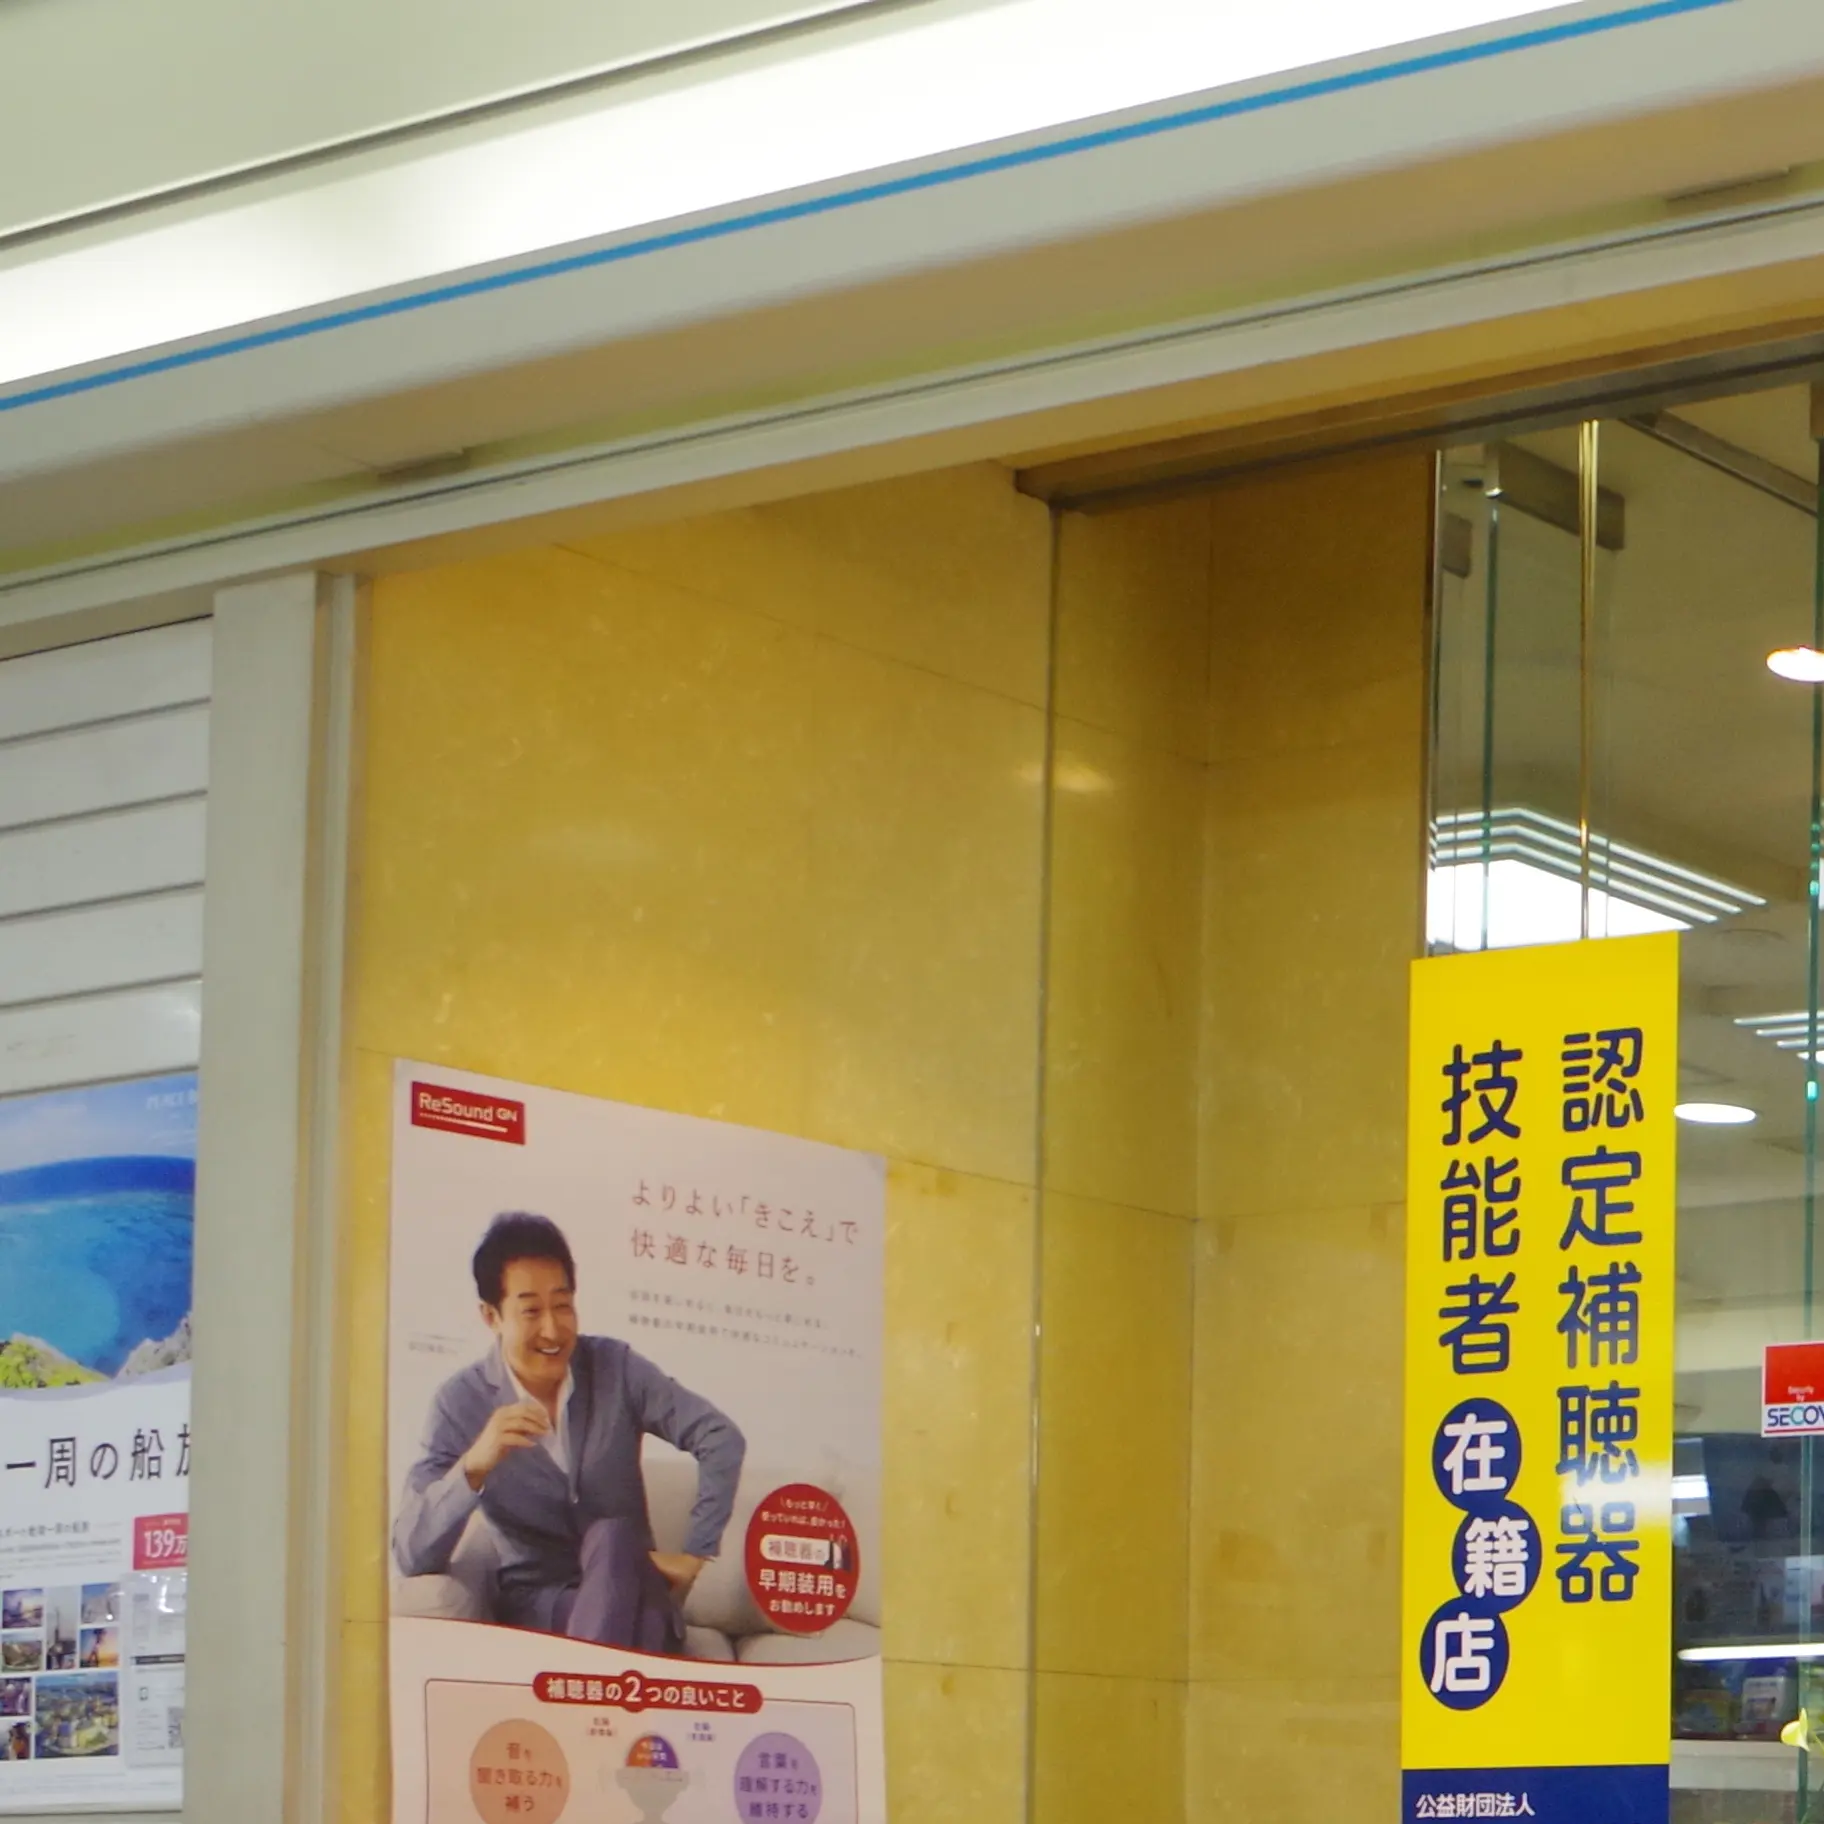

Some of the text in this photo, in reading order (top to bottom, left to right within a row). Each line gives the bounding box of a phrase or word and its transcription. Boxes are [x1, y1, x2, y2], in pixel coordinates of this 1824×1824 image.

[419, 1092, 493, 1121] ReSound
[631, 1180, 859, 1244] よりよい「きこえ」で
[631, 1227, 815, 1286] 快適な毎日を。
[1555, 1027, 1644, 1605] 認定補聴器
[546, 1676, 747, 1709] 補聴器の2つの良いこと
[1416, 1793, 1536, 1818] 公益財団法人
